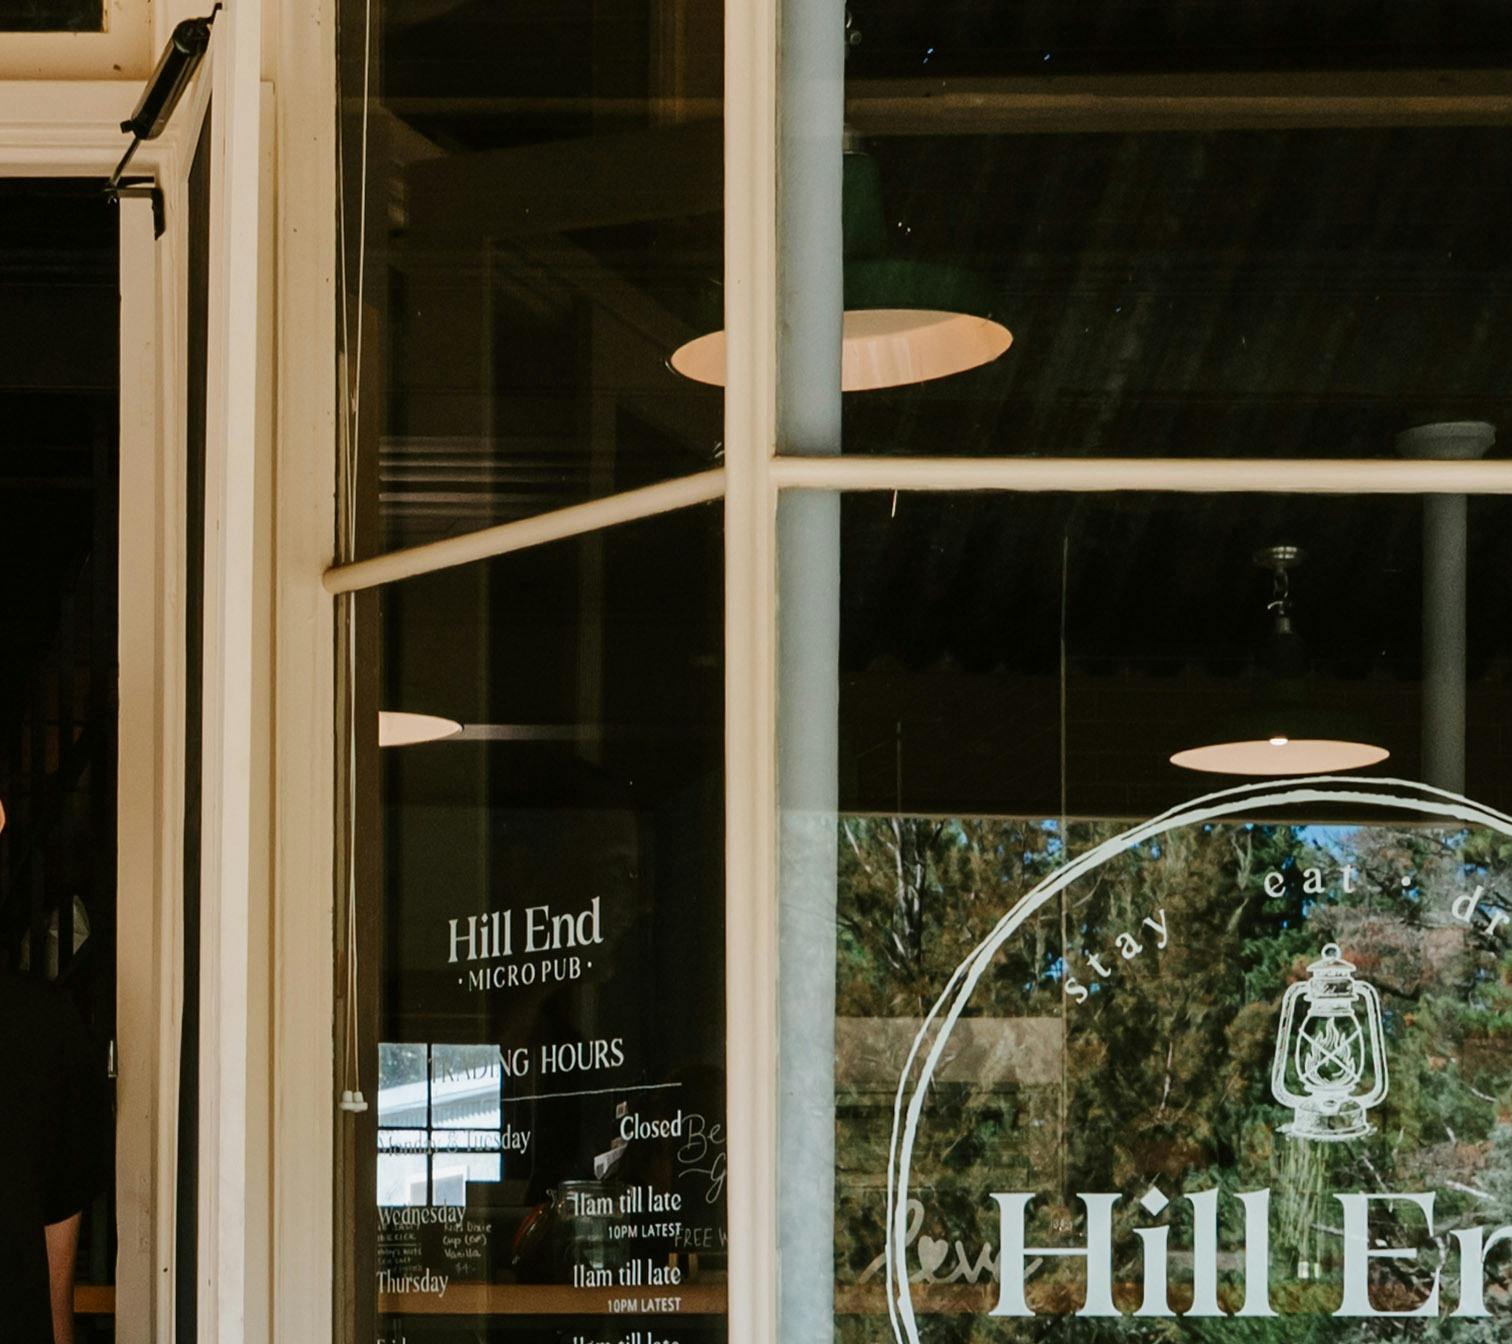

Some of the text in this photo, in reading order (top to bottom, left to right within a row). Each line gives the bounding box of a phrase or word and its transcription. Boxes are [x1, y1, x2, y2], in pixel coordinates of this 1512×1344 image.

[1262, 862, 1358, 900] eat
[447, 895, 605, 964] Hill End
[467, 956, 582, 992] MICRO PUB
[1065, 904, 1173, 1006] stay
[540, 1038, 625, 1075] HOURS
[619, 1109, 683, 1142] Closed
[377, 1185, 682, 1230] Wednesday 11am till late
[607, 1222, 682, 1240] 10PM LATEST
[987, 1185, 1282, 1319] Hill
[375, 1267, 449, 1298] Thursday
[573, 1263, 612, 1288] 11am
[618, 1259, 642, 1287] till
[647, 1258, 682, 1286] late
[607, 1296, 682, 1313] 10PM LATEST
